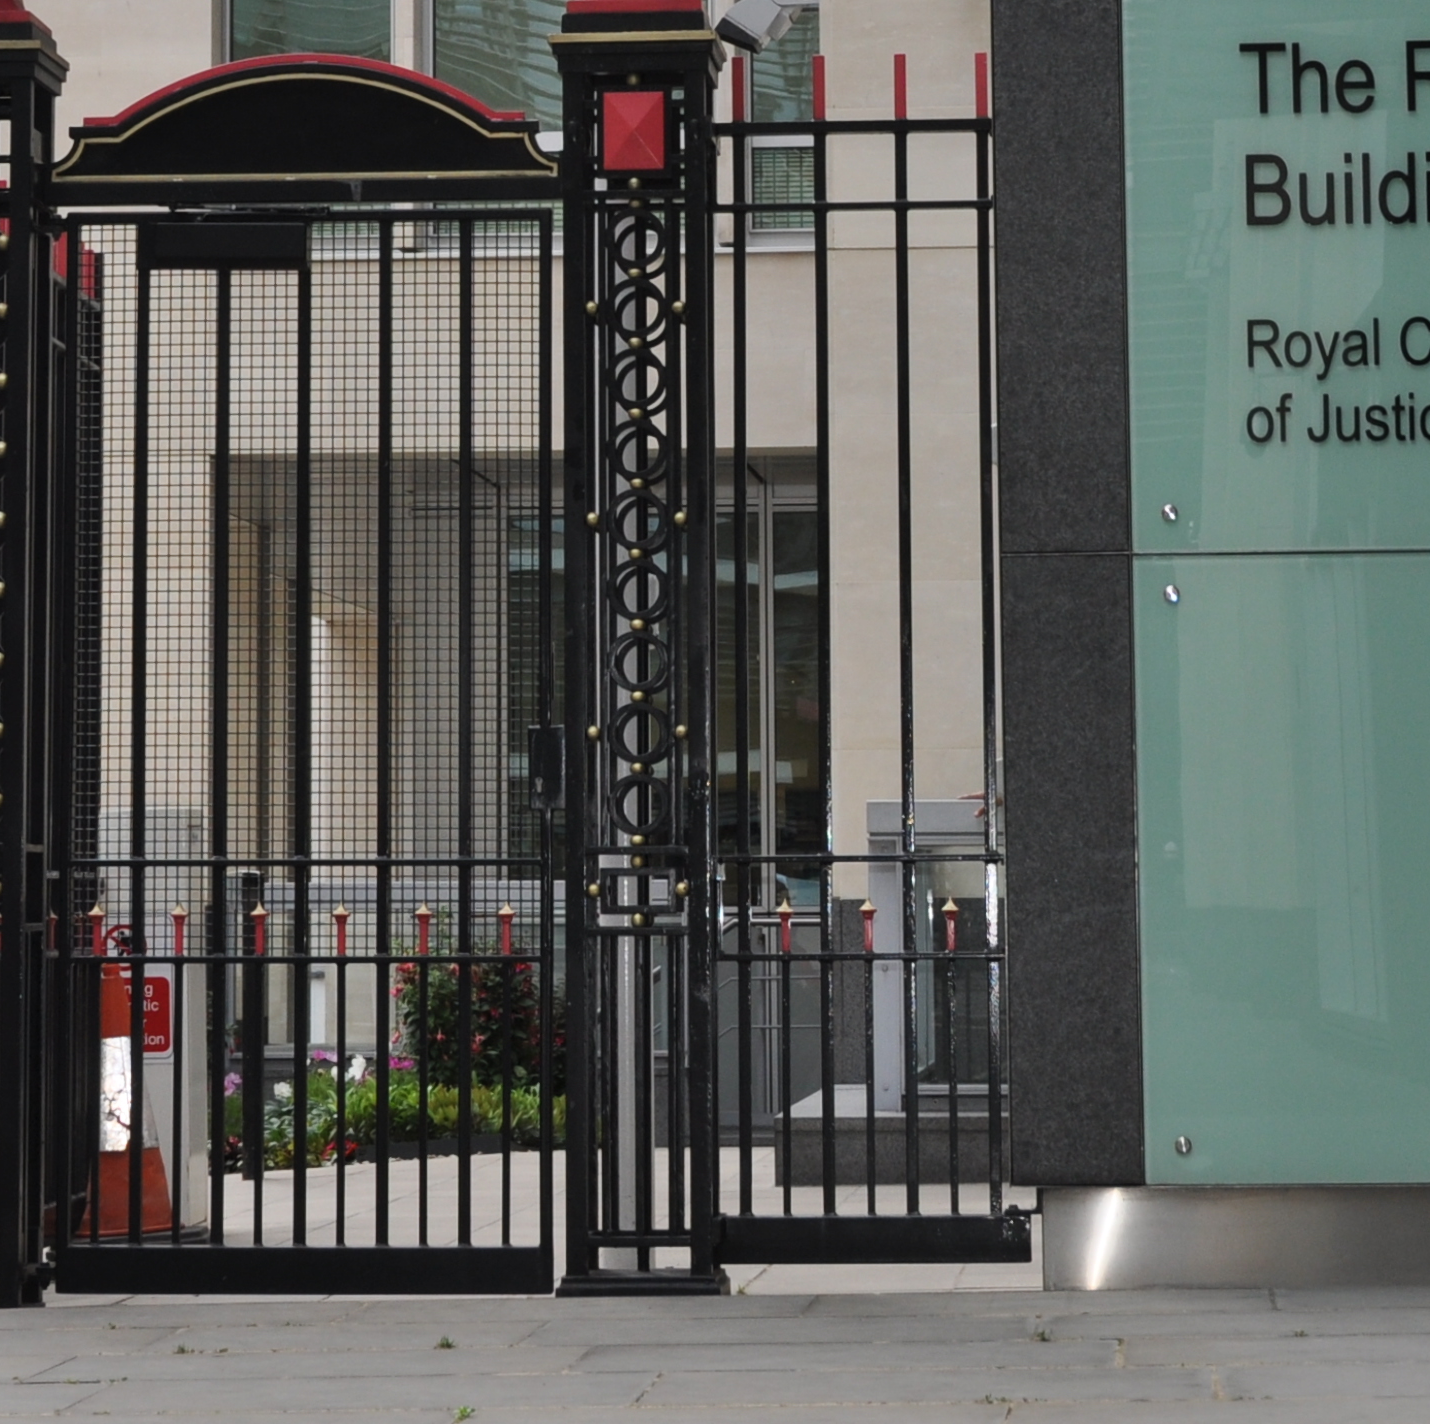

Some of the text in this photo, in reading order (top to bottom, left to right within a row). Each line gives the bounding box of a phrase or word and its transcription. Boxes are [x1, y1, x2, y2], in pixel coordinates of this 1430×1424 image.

[1239, 42, 1376, 114] The
[1246, 317, 1380, 381] Royal
[1246, 392, 1293, 443] of
